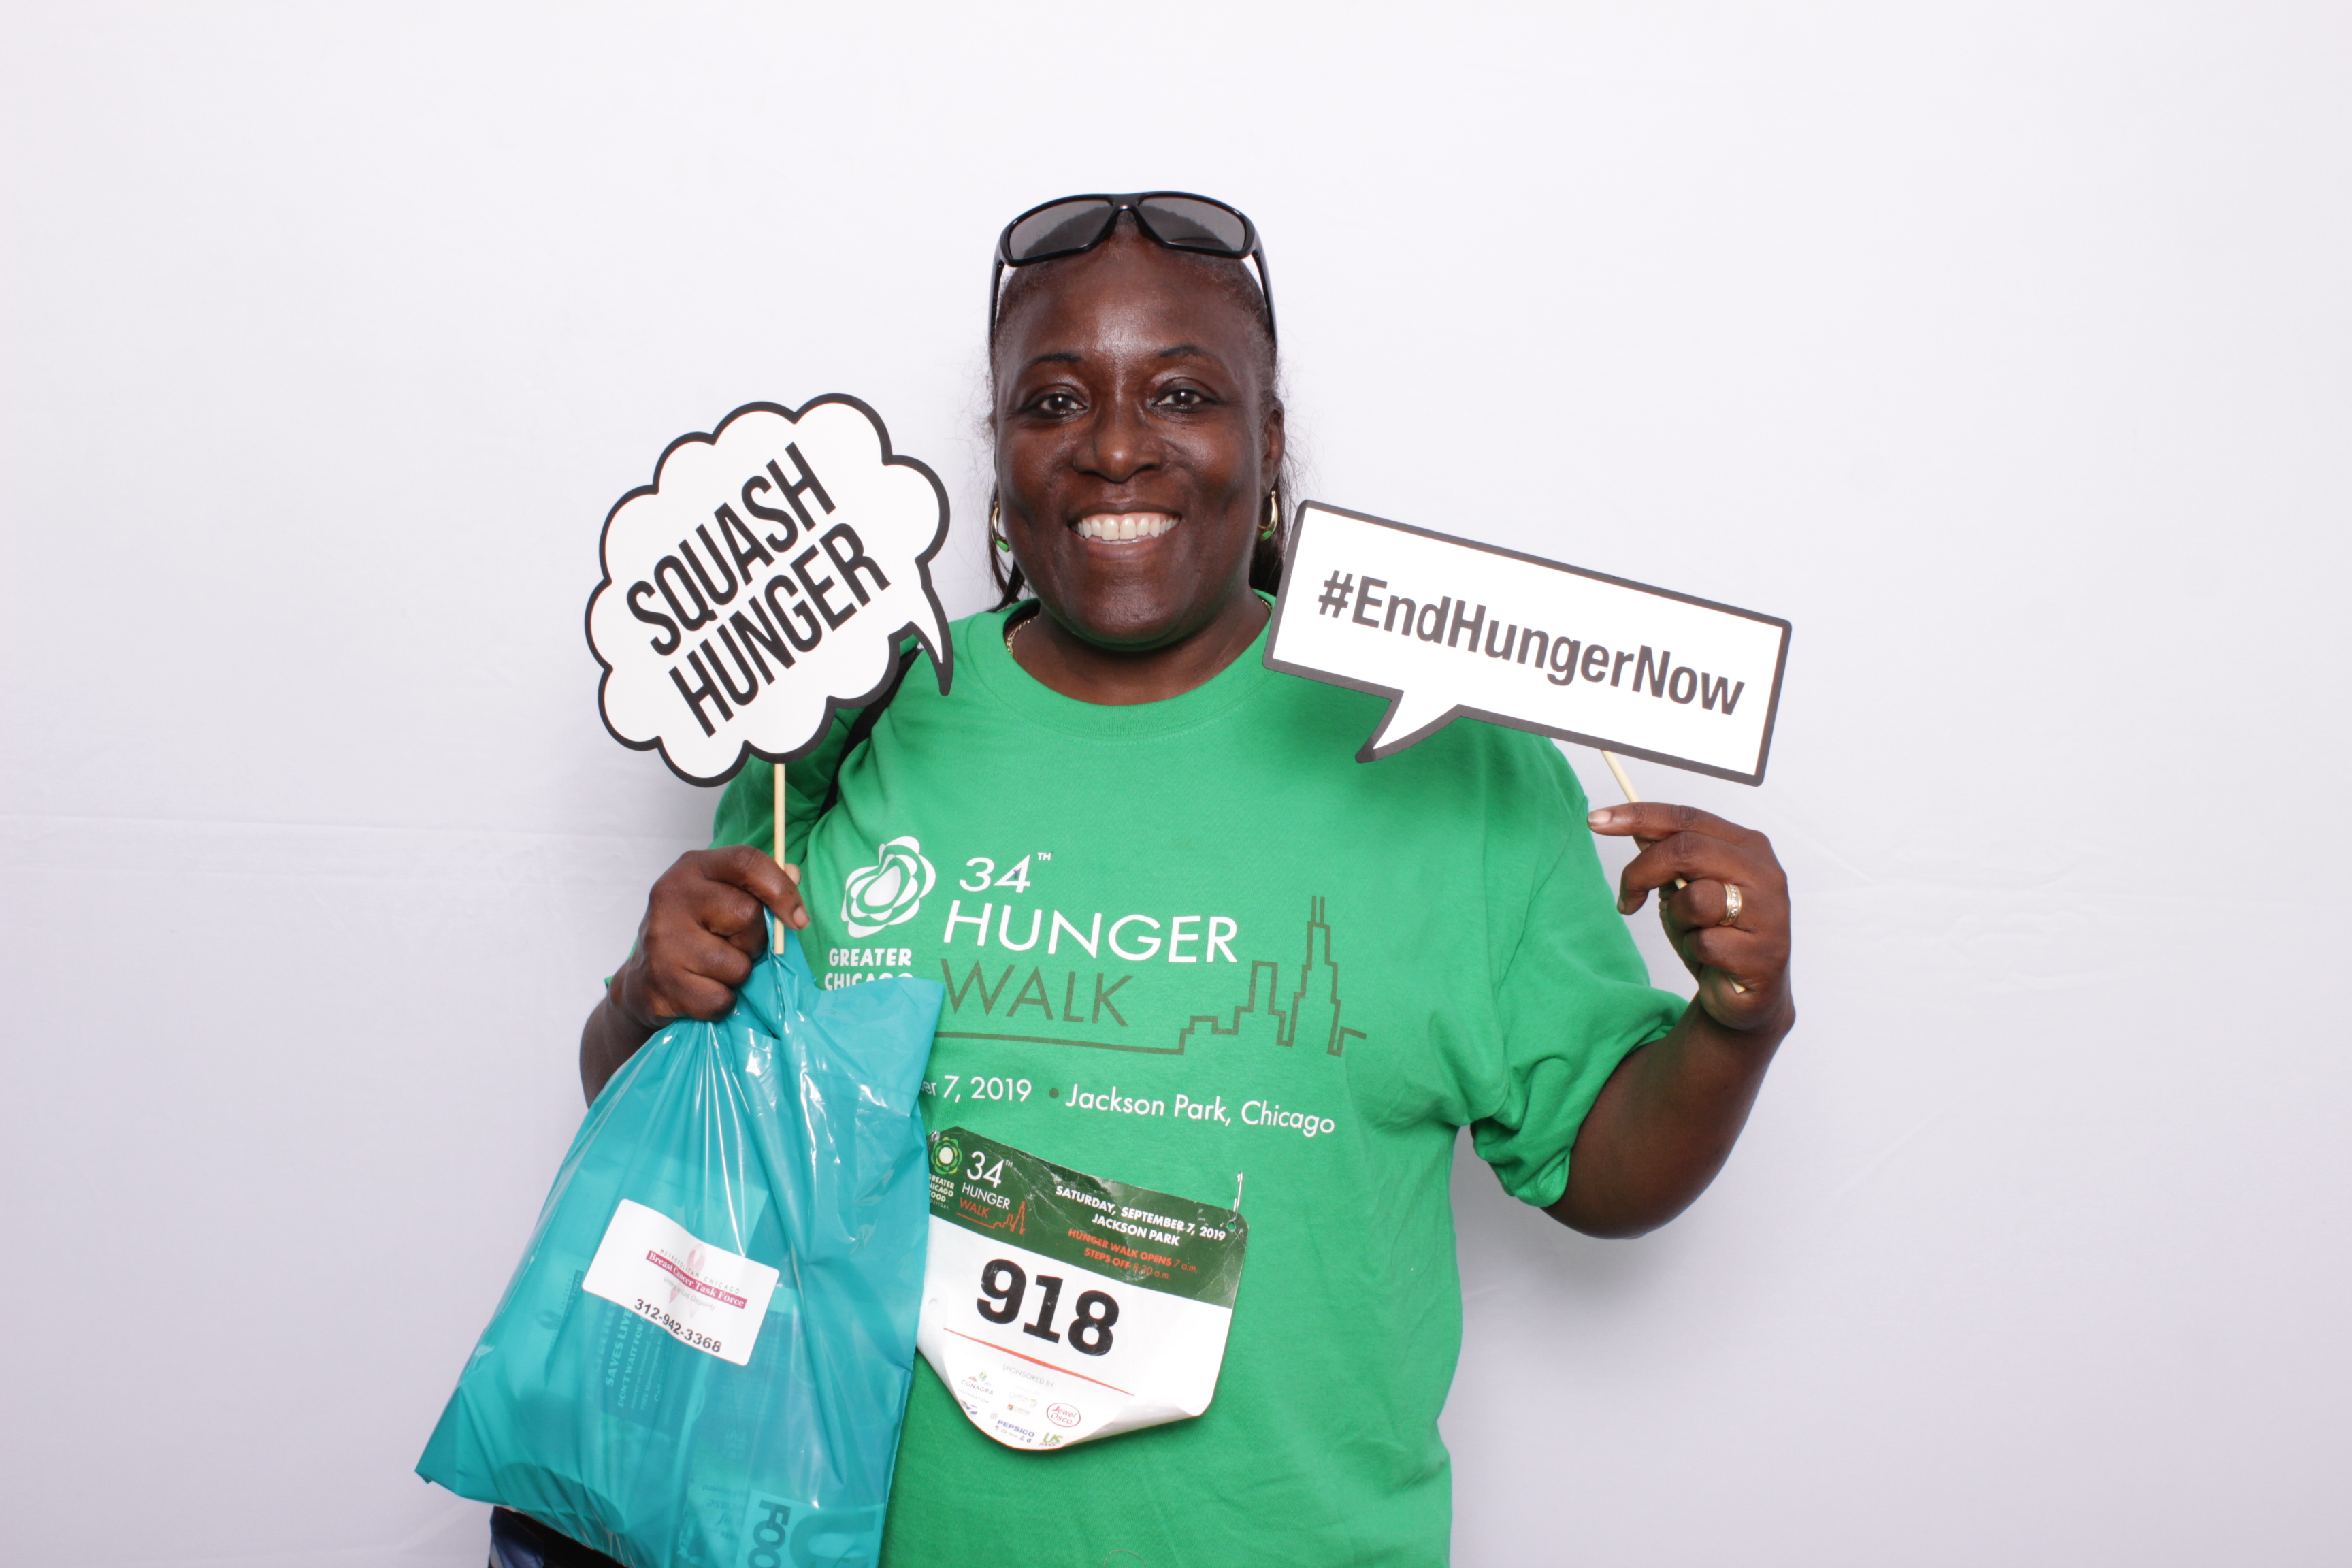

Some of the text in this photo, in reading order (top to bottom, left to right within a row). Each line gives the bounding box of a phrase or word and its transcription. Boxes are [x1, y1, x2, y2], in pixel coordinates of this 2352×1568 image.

[626, 441, 836, 656] SQUASH
[668, 523, 891, 738] HUNGER
[1318, 570, 1745, 716] #EndHungerNow
[943, 900, 1238, 964] HUNGER
[829, 947, 912, 966] GREATER
[941, 958, 1134, 1028] WALK
[920, 1075, 1032, 1102] er 7, 2019
[1065, 1083, 1335, 1139] Jackson Park, Chicago
[930, 1190, 946, 1203] OOD
[960, 1197, 990, 1218] WALK
[962, 1182, 1011, 1210] HUNGER
[1056, 1186, 1226, 1241] SATURDAY, SEPTEMBER 7, 2019
[1092, 1213, 1181, 1246] JACKSON PARK
[659, 1248, 700, 1278] METROPOLITAN
[1068, 1228, 1198, 1273] HUNGER WALK OPENS 7 a.m.
[1085, 1247, 1171, 1280] STEPS OFF 8:30 a.m.
[649, 1252, 745, 1307] Breast Cancer Task Force
[681, 1288, 690, 1299] End
[704, 1276, 740, 1294] CHICAGO
[977, 1258, 1120, 1356] 918
[634, 1298, 722, 1353] 312-942-3368
[605, 1341, 623, 1386] SAVES
[625, 1345, 638, 1373] WAIT
[634, 1324, 644, 1345] FOR
[961, 1379, 994, 1395] CONAGRA
[1002, 1364, 1045, 1384] SPONSORED
[1052, 1405, 1077, 1418] Jewel
[997, 1420, 1035, 1438] PEPSICO
